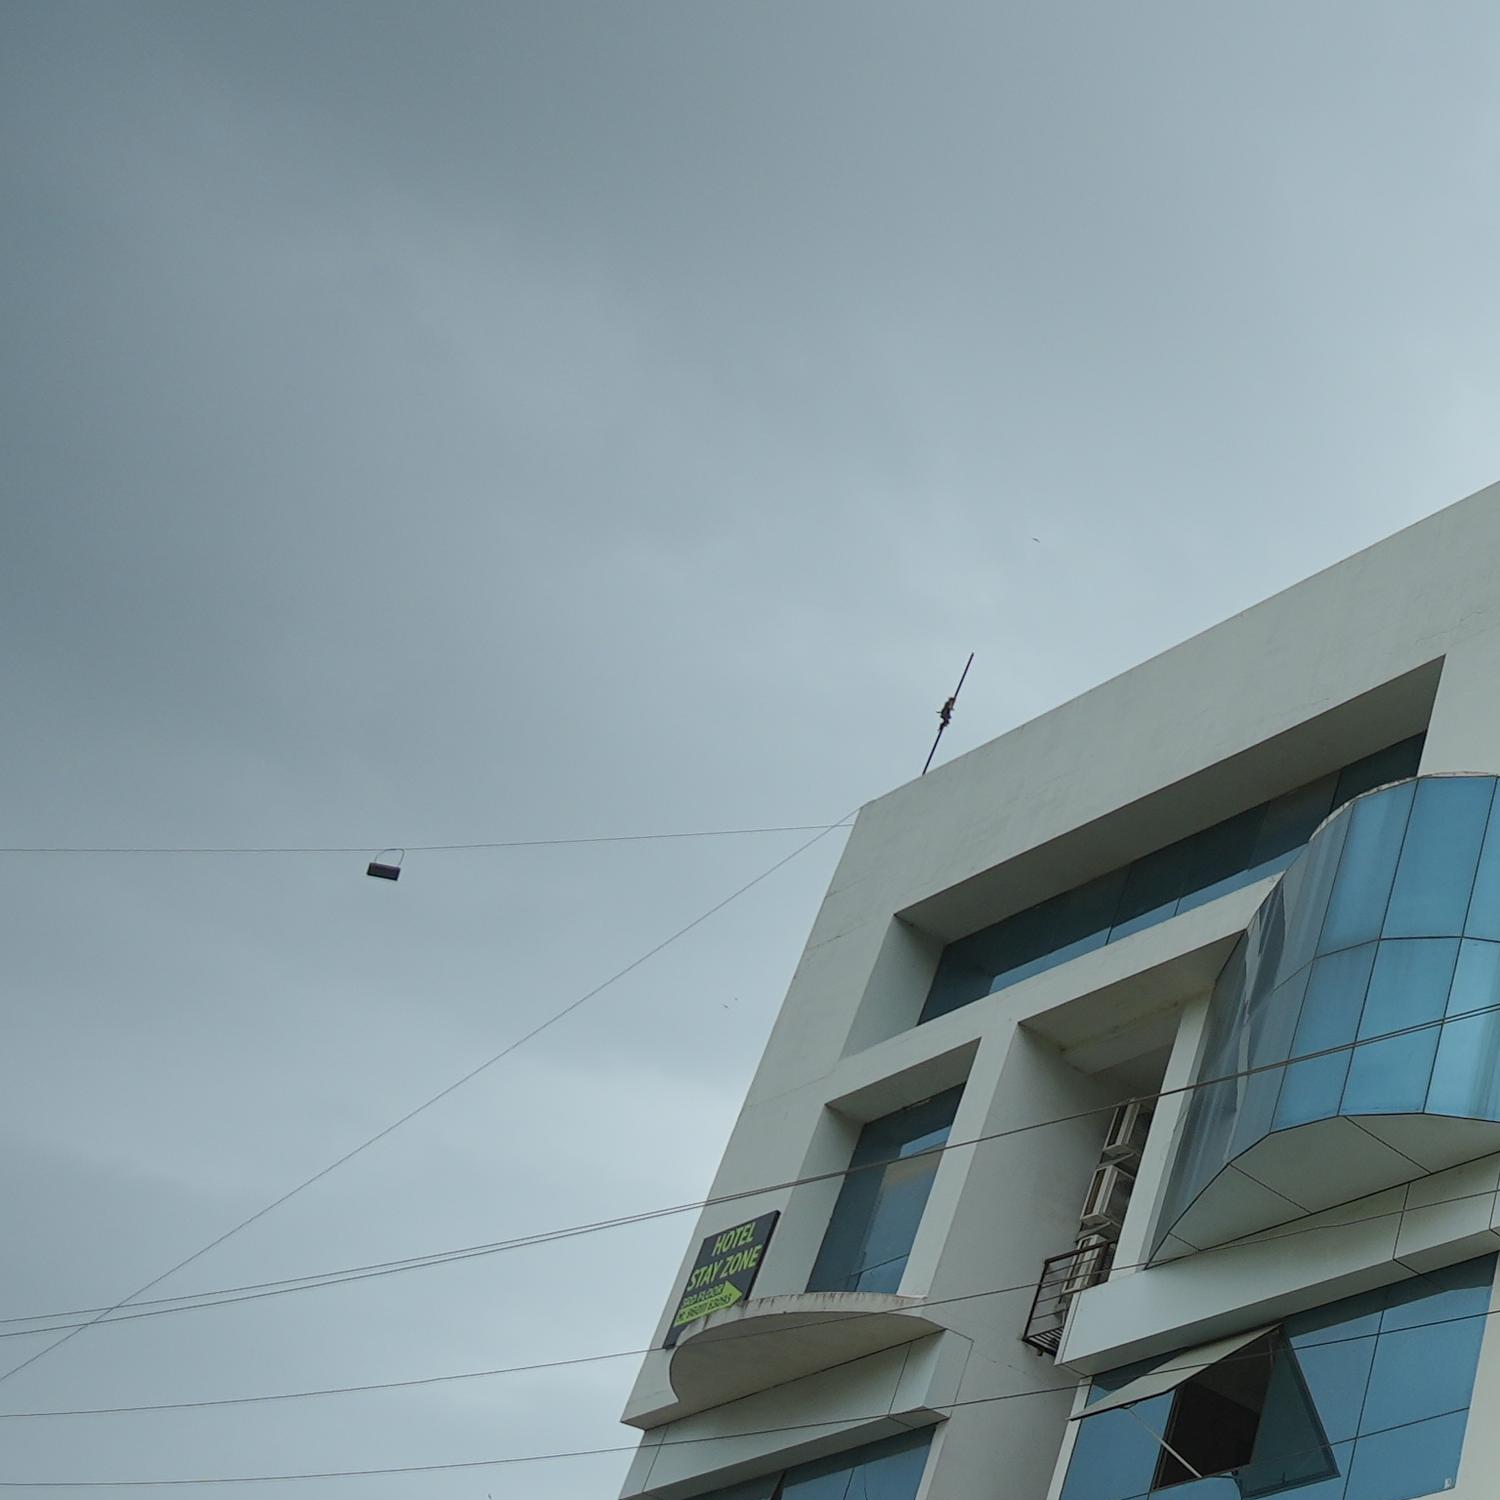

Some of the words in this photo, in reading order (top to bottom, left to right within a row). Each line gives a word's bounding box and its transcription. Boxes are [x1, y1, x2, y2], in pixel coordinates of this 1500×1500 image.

[712, 1222, 757, 1257] HOTEL
[687, 1260, 722, 1291] STAY
[719, 1244, 764, 1279] ZONE
